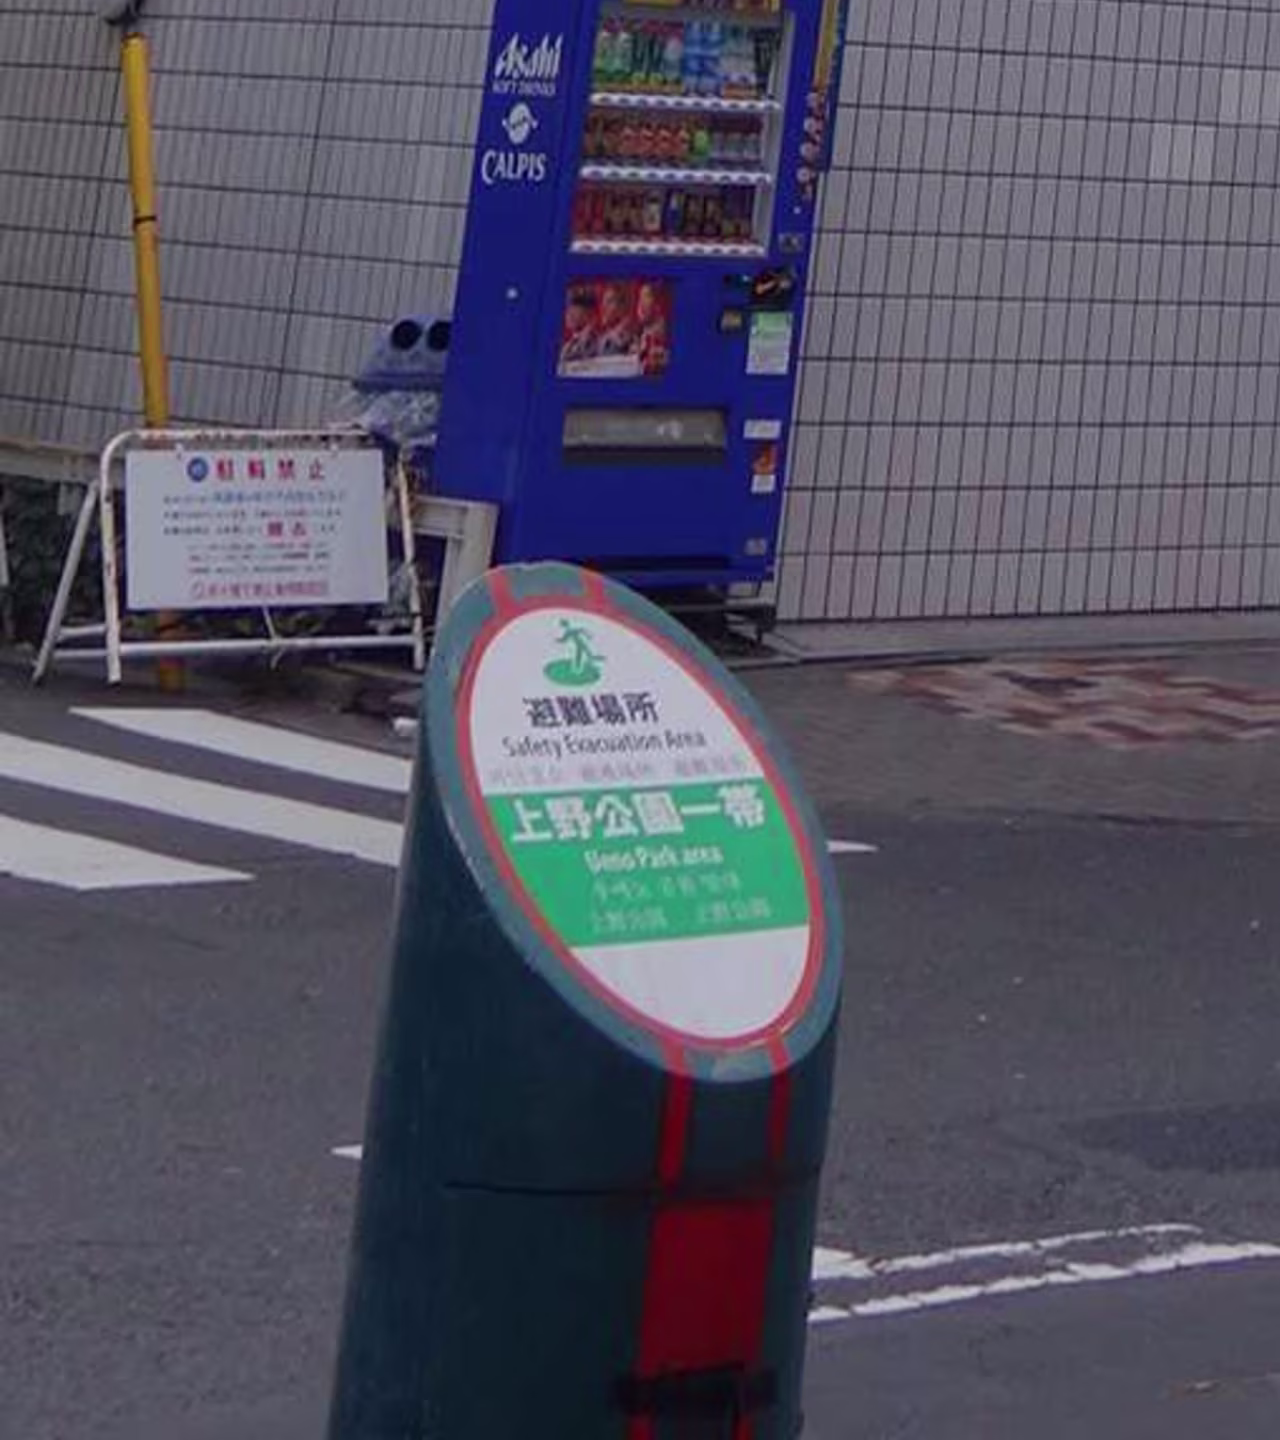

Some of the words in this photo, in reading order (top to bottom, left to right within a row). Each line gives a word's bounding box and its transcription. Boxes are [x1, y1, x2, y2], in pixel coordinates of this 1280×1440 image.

[494, 33, 563, 78] Asahi
[482, 149, 547, 185] CALPIS
[523, 692, 660, 728] 避難場所
[502, 734, 562, 759] Safety
[564, 733, 663, 754] Evacuation
[666, 730, 706, 749] Area
[511, 783, 766, 843] 上野公園一帯
[636, 846, 679, 868] Park
